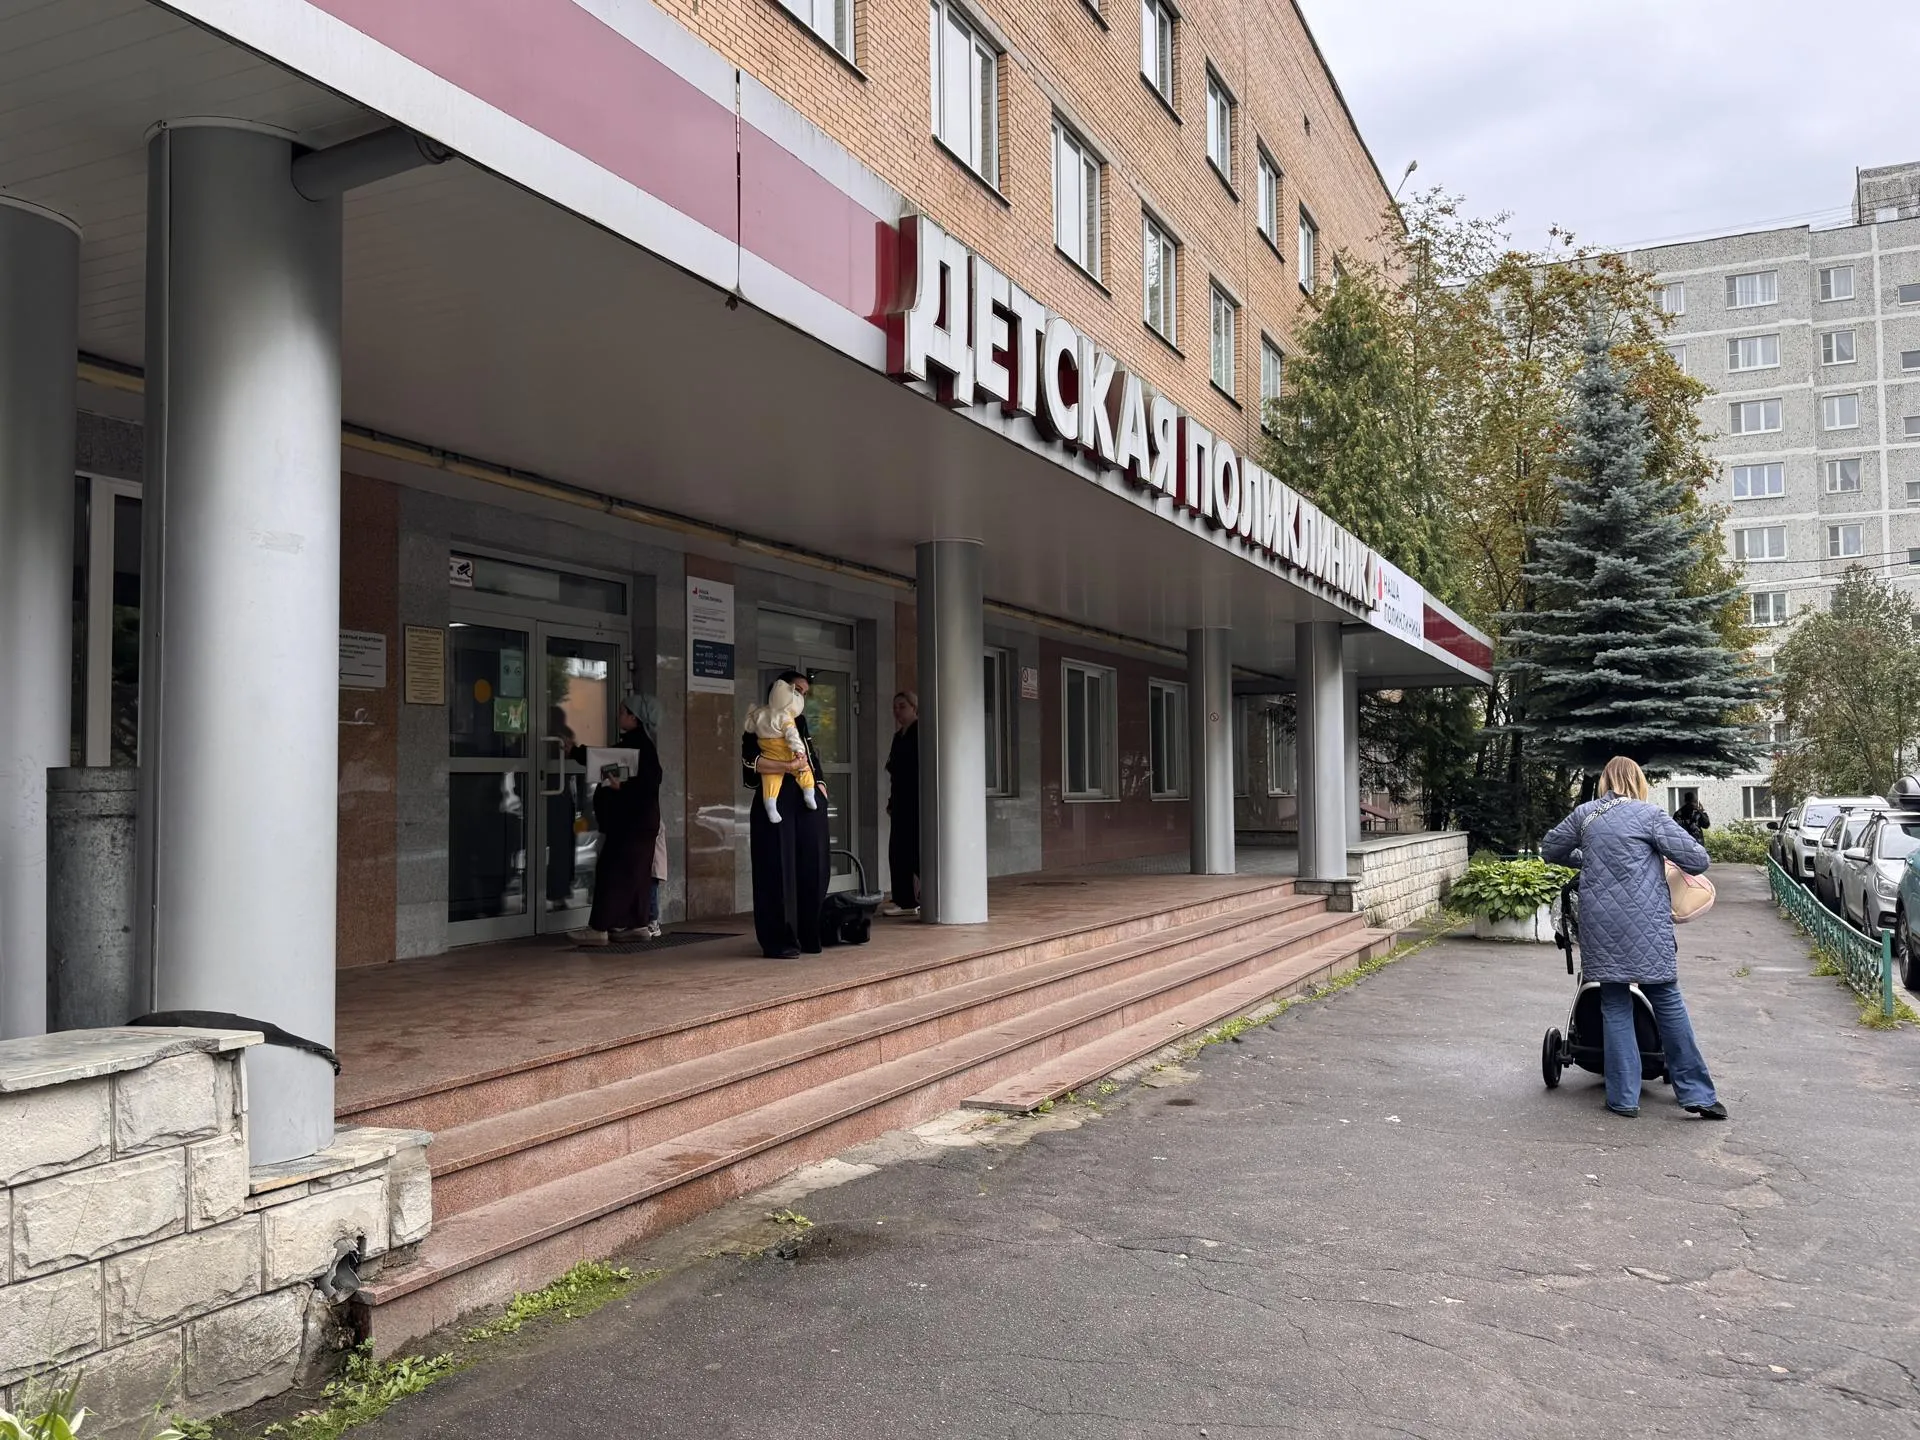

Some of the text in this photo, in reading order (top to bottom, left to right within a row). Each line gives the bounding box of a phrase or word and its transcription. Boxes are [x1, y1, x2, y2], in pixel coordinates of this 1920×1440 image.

[903, 212, 1379, 612] ДЕТСКАЯ ПОЛИКЛИНИКА
[1383, 573, 1400, 601] НАША
[1383, 601, 1421, 640] ПОЛИКЛИНИКА
